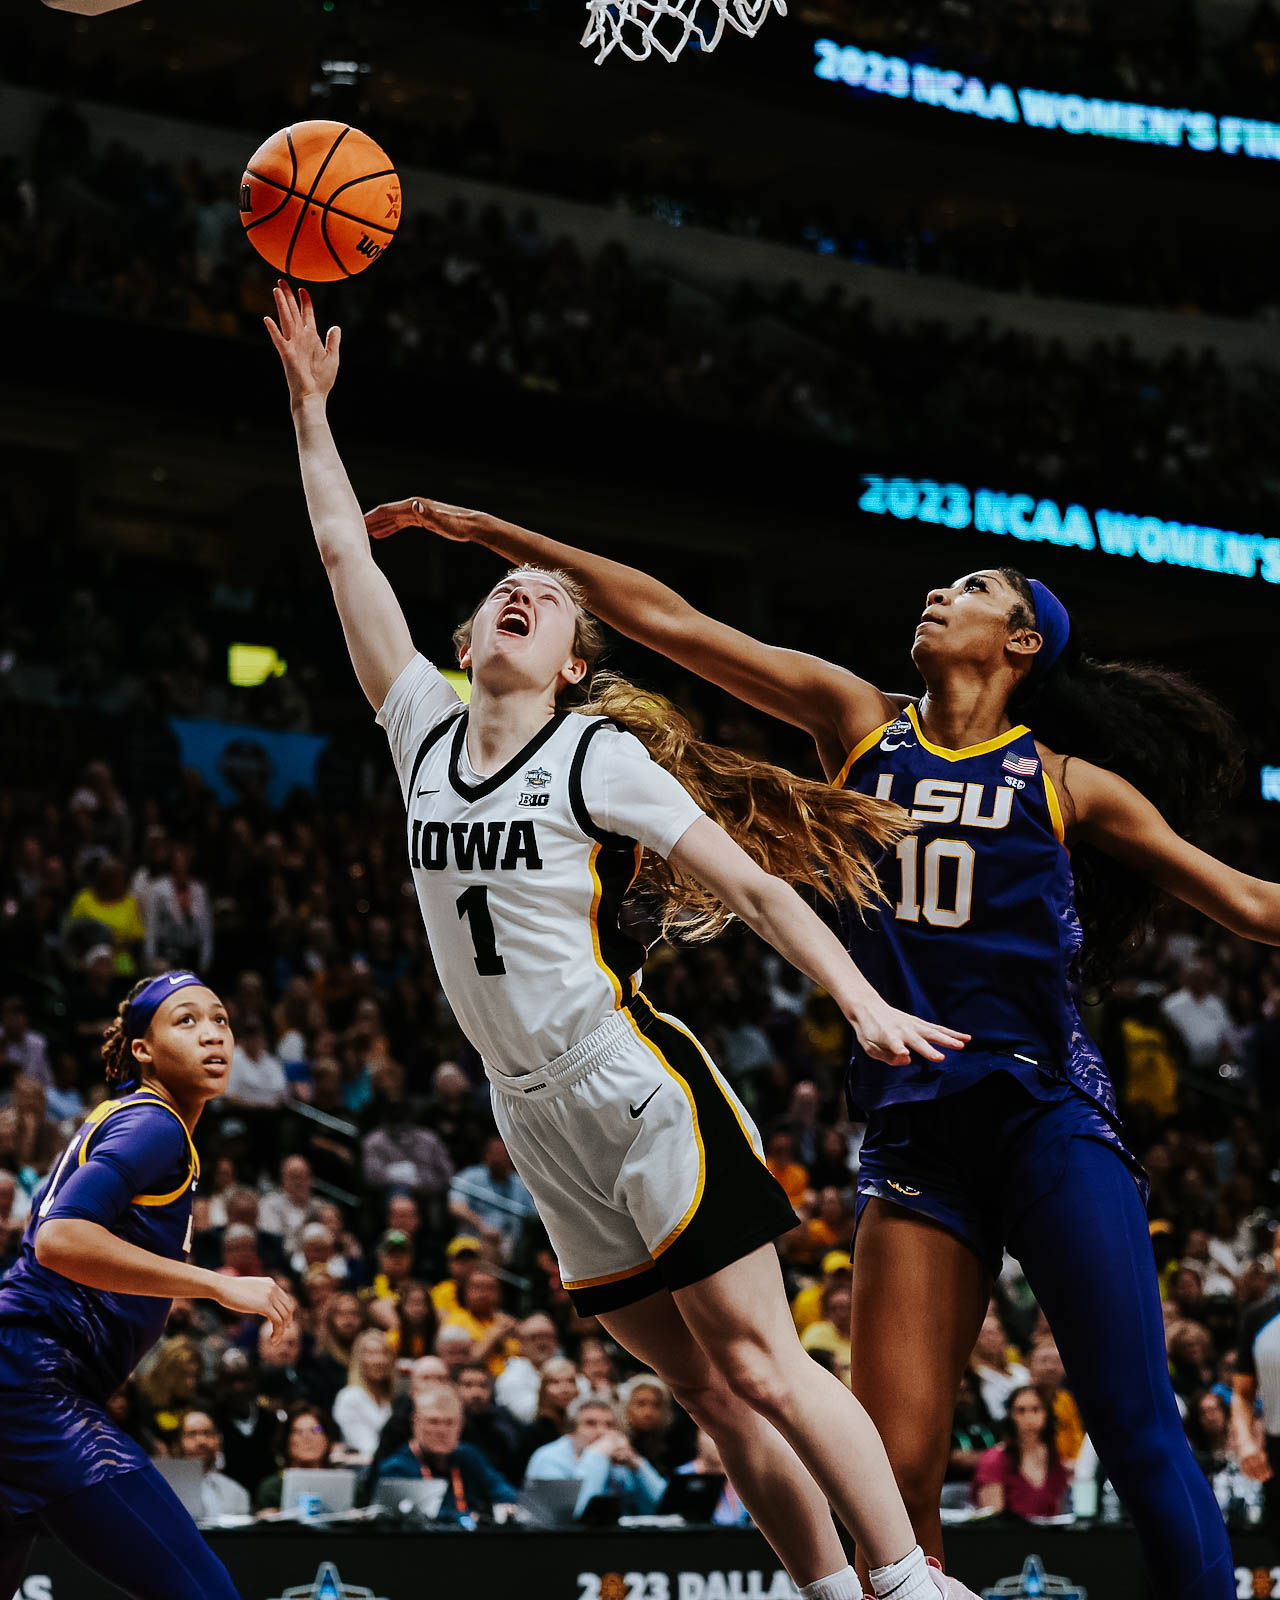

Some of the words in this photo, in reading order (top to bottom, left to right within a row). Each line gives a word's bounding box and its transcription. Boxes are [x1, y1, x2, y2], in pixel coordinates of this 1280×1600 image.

[814, 38, 910, 98] 2023
[912, 63, 1019, 123] NCAA
[1018, 87, 1218, 151] WOMEN'S
[858, 473, 972, 530] 2023
[974, 487, 1096, 550] NCAA
[876, 773, 1014, 829] LSU
[1005, 776, 1026, 790] SEC
[411, 819, 543, 871] IOWA
[895, 835, 976, 928] 10
[455, 885, 507, 977] 1
[677, 1570, 800, 1600] DALLA
